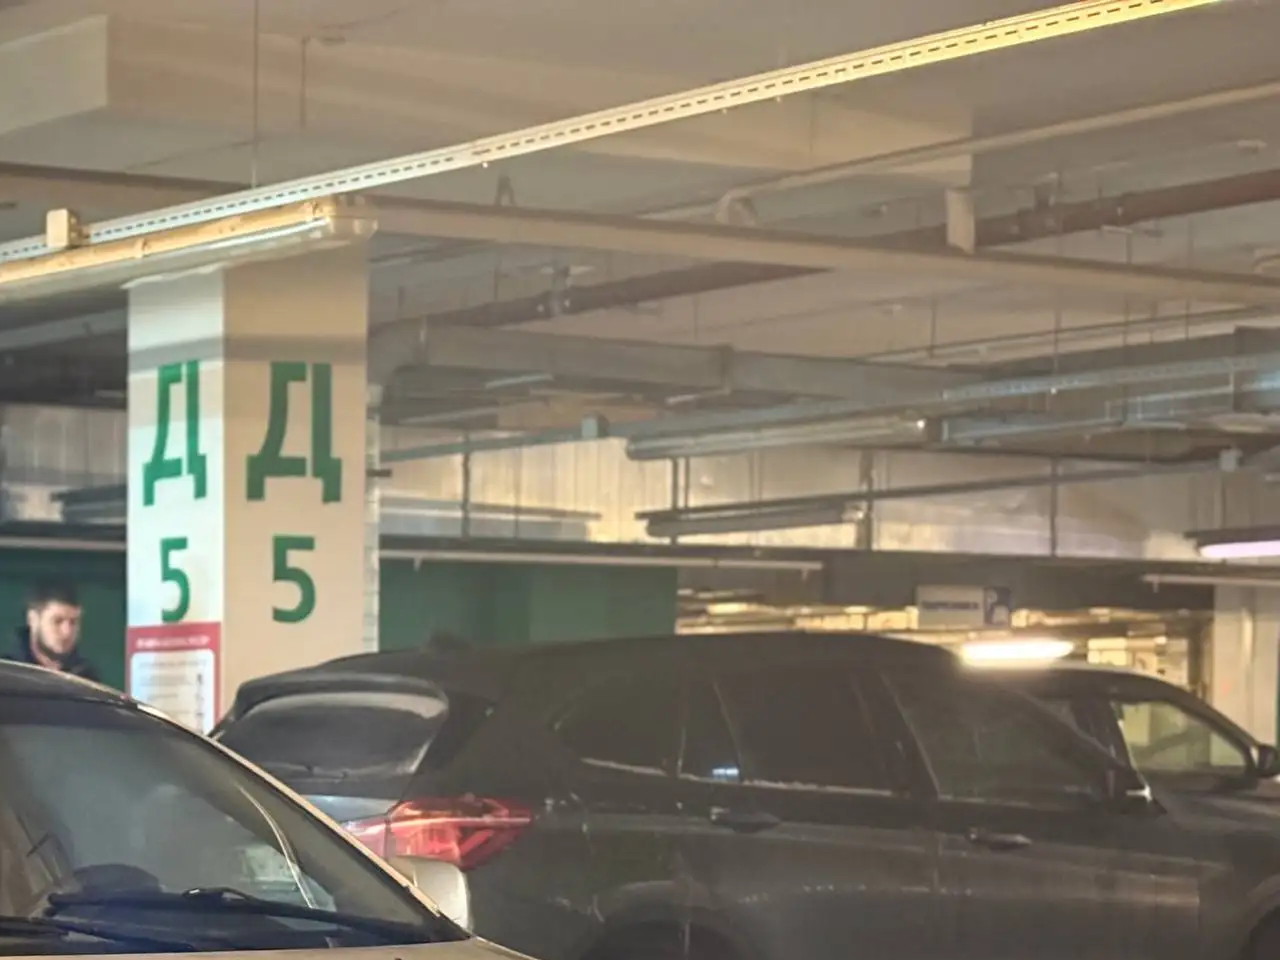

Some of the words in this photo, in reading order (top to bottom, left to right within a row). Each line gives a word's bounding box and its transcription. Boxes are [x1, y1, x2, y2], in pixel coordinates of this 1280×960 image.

[142, 359, 207, 506] Д
[246, 361, 342, 503] Д
[160, 537, 191, 623] 5
[272, 534, 316, 623] 5
